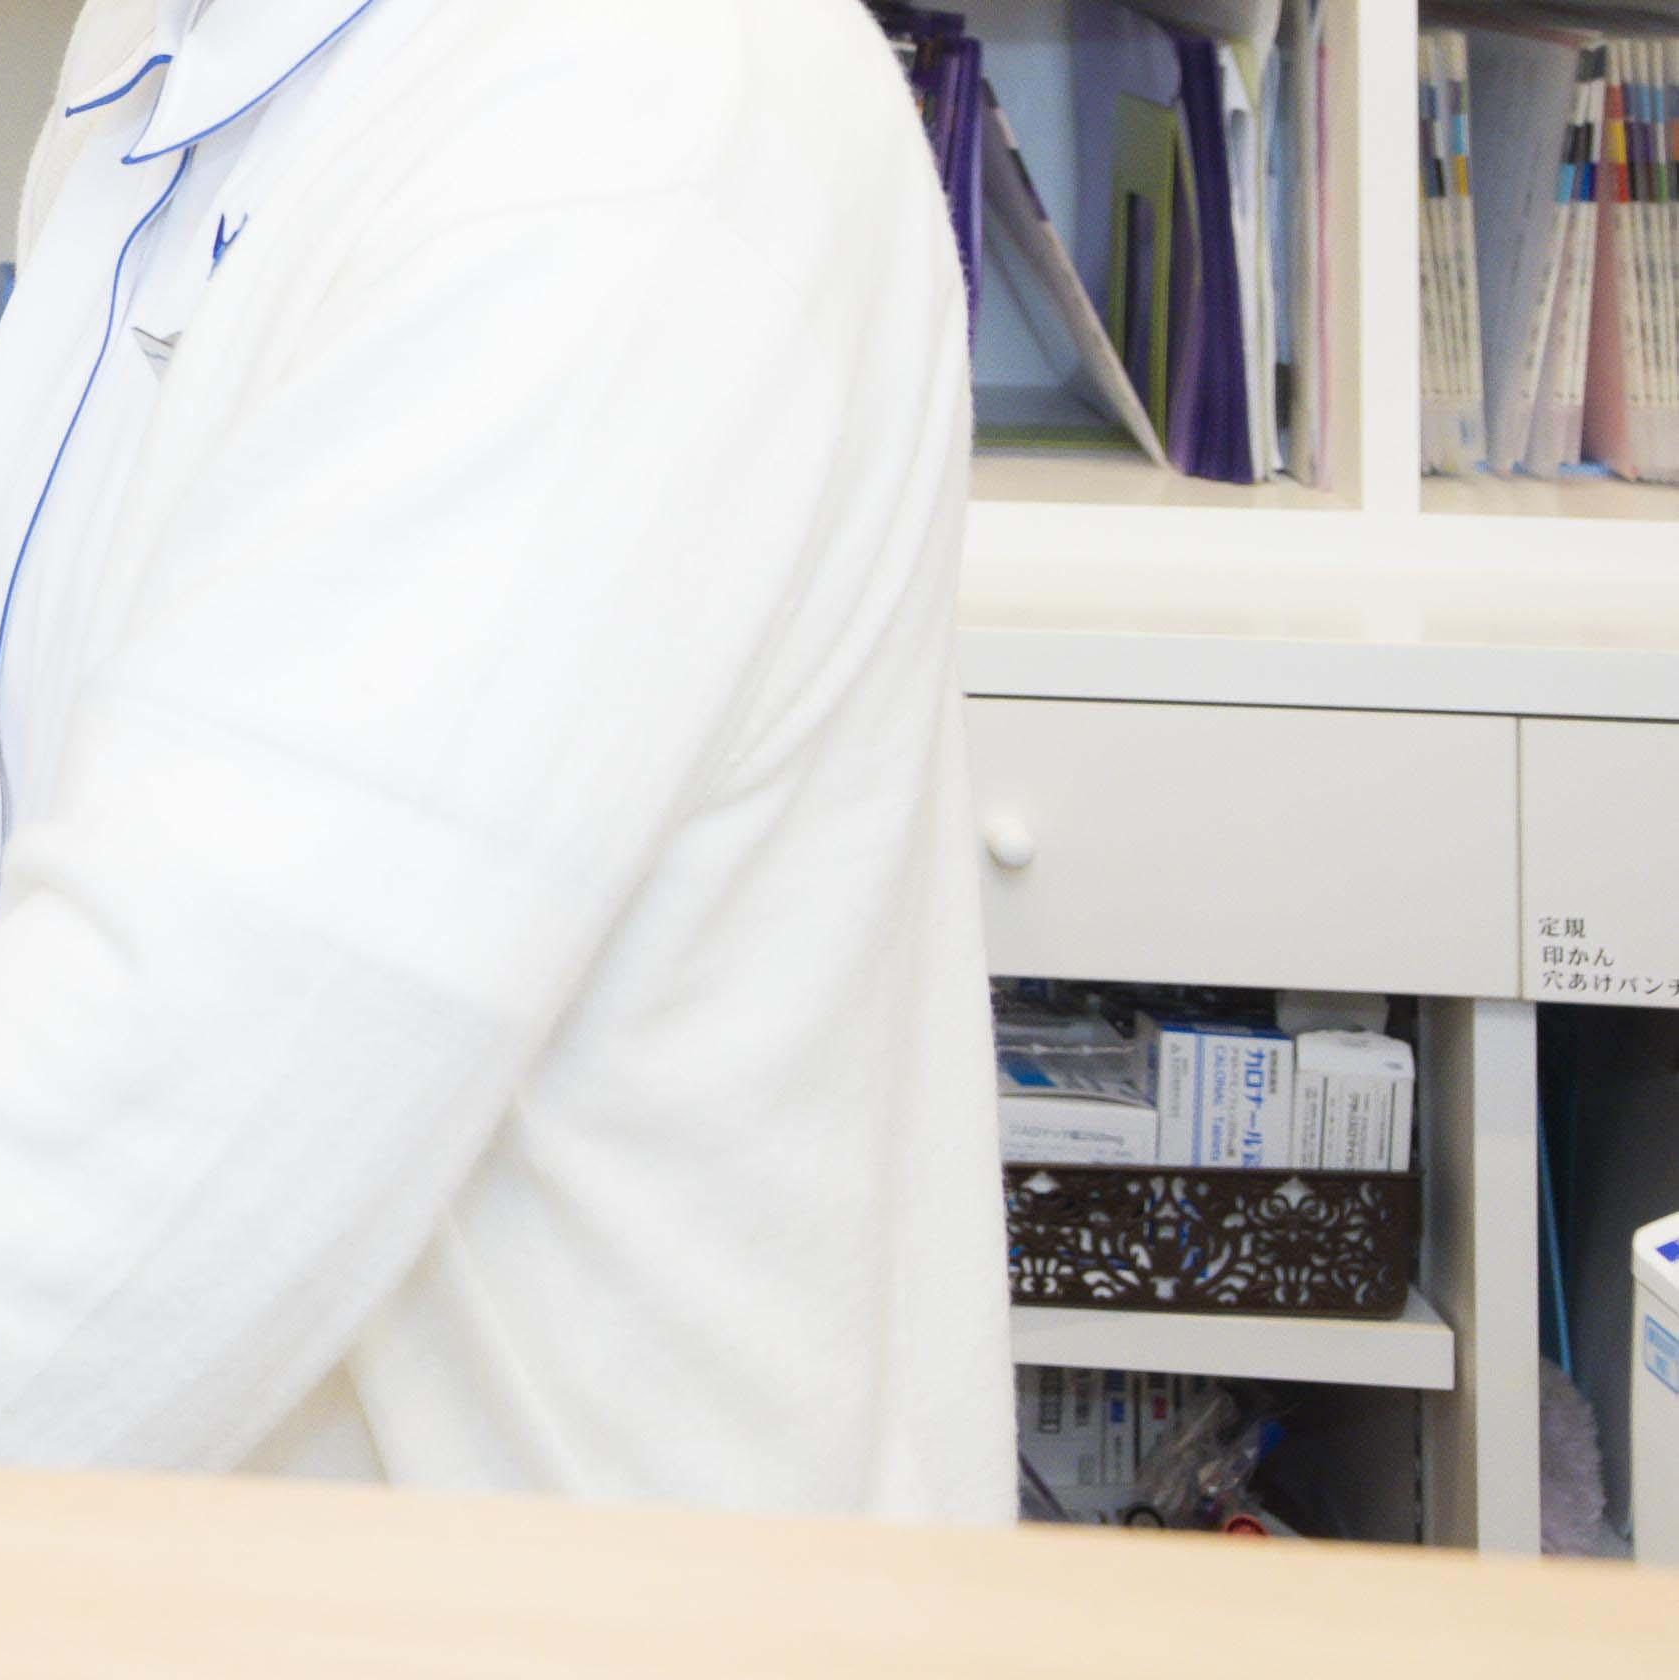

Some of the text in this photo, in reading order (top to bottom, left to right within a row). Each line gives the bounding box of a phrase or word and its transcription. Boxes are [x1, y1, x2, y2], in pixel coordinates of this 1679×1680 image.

[1539, 917, 1586, 938] 定規
[1543, 944, 1615, 966] 印かん
